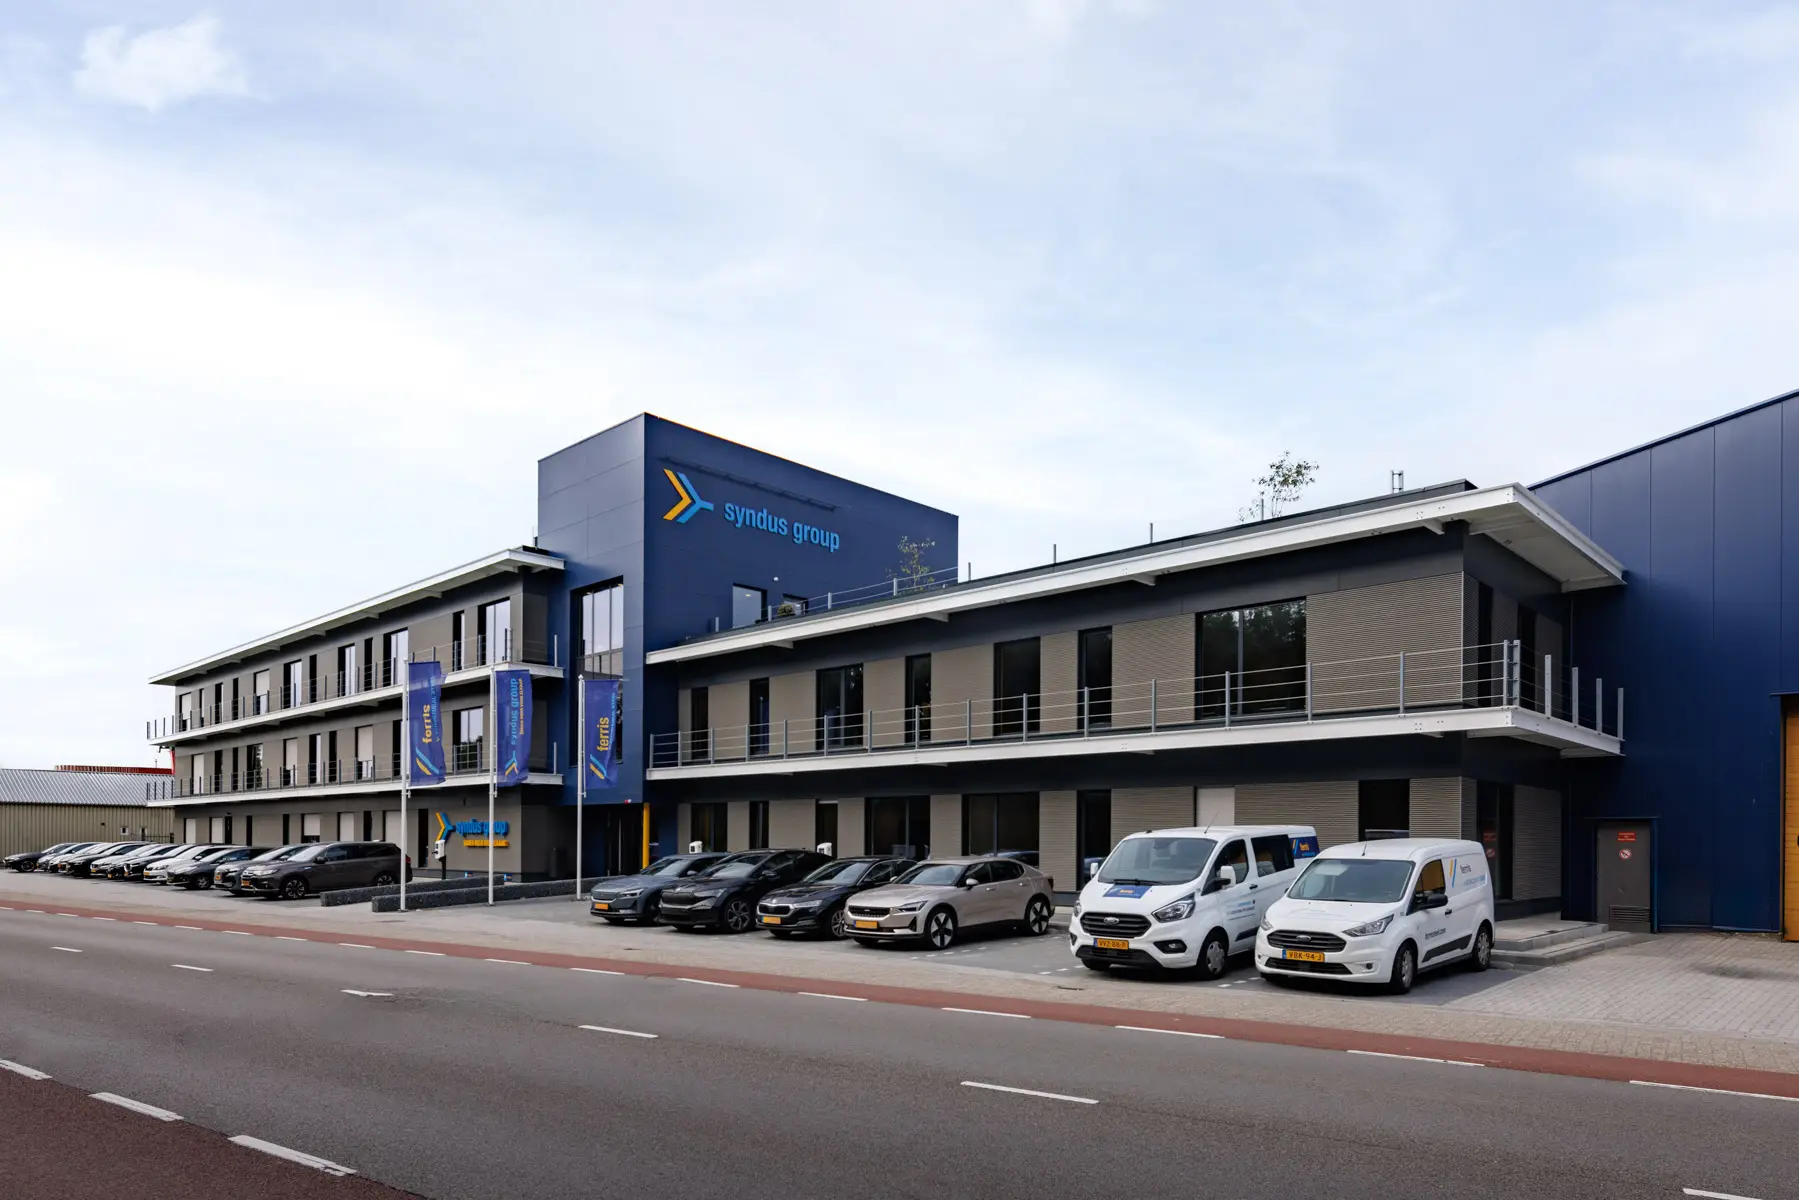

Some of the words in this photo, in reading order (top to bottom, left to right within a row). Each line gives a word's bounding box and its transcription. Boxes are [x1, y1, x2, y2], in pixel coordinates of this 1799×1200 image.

[724, 502, 788, 536] syndus
[792, 521, 840, 553] group
[510, 678, 519, 708] group
[597, 717, 609, 751] ferris
